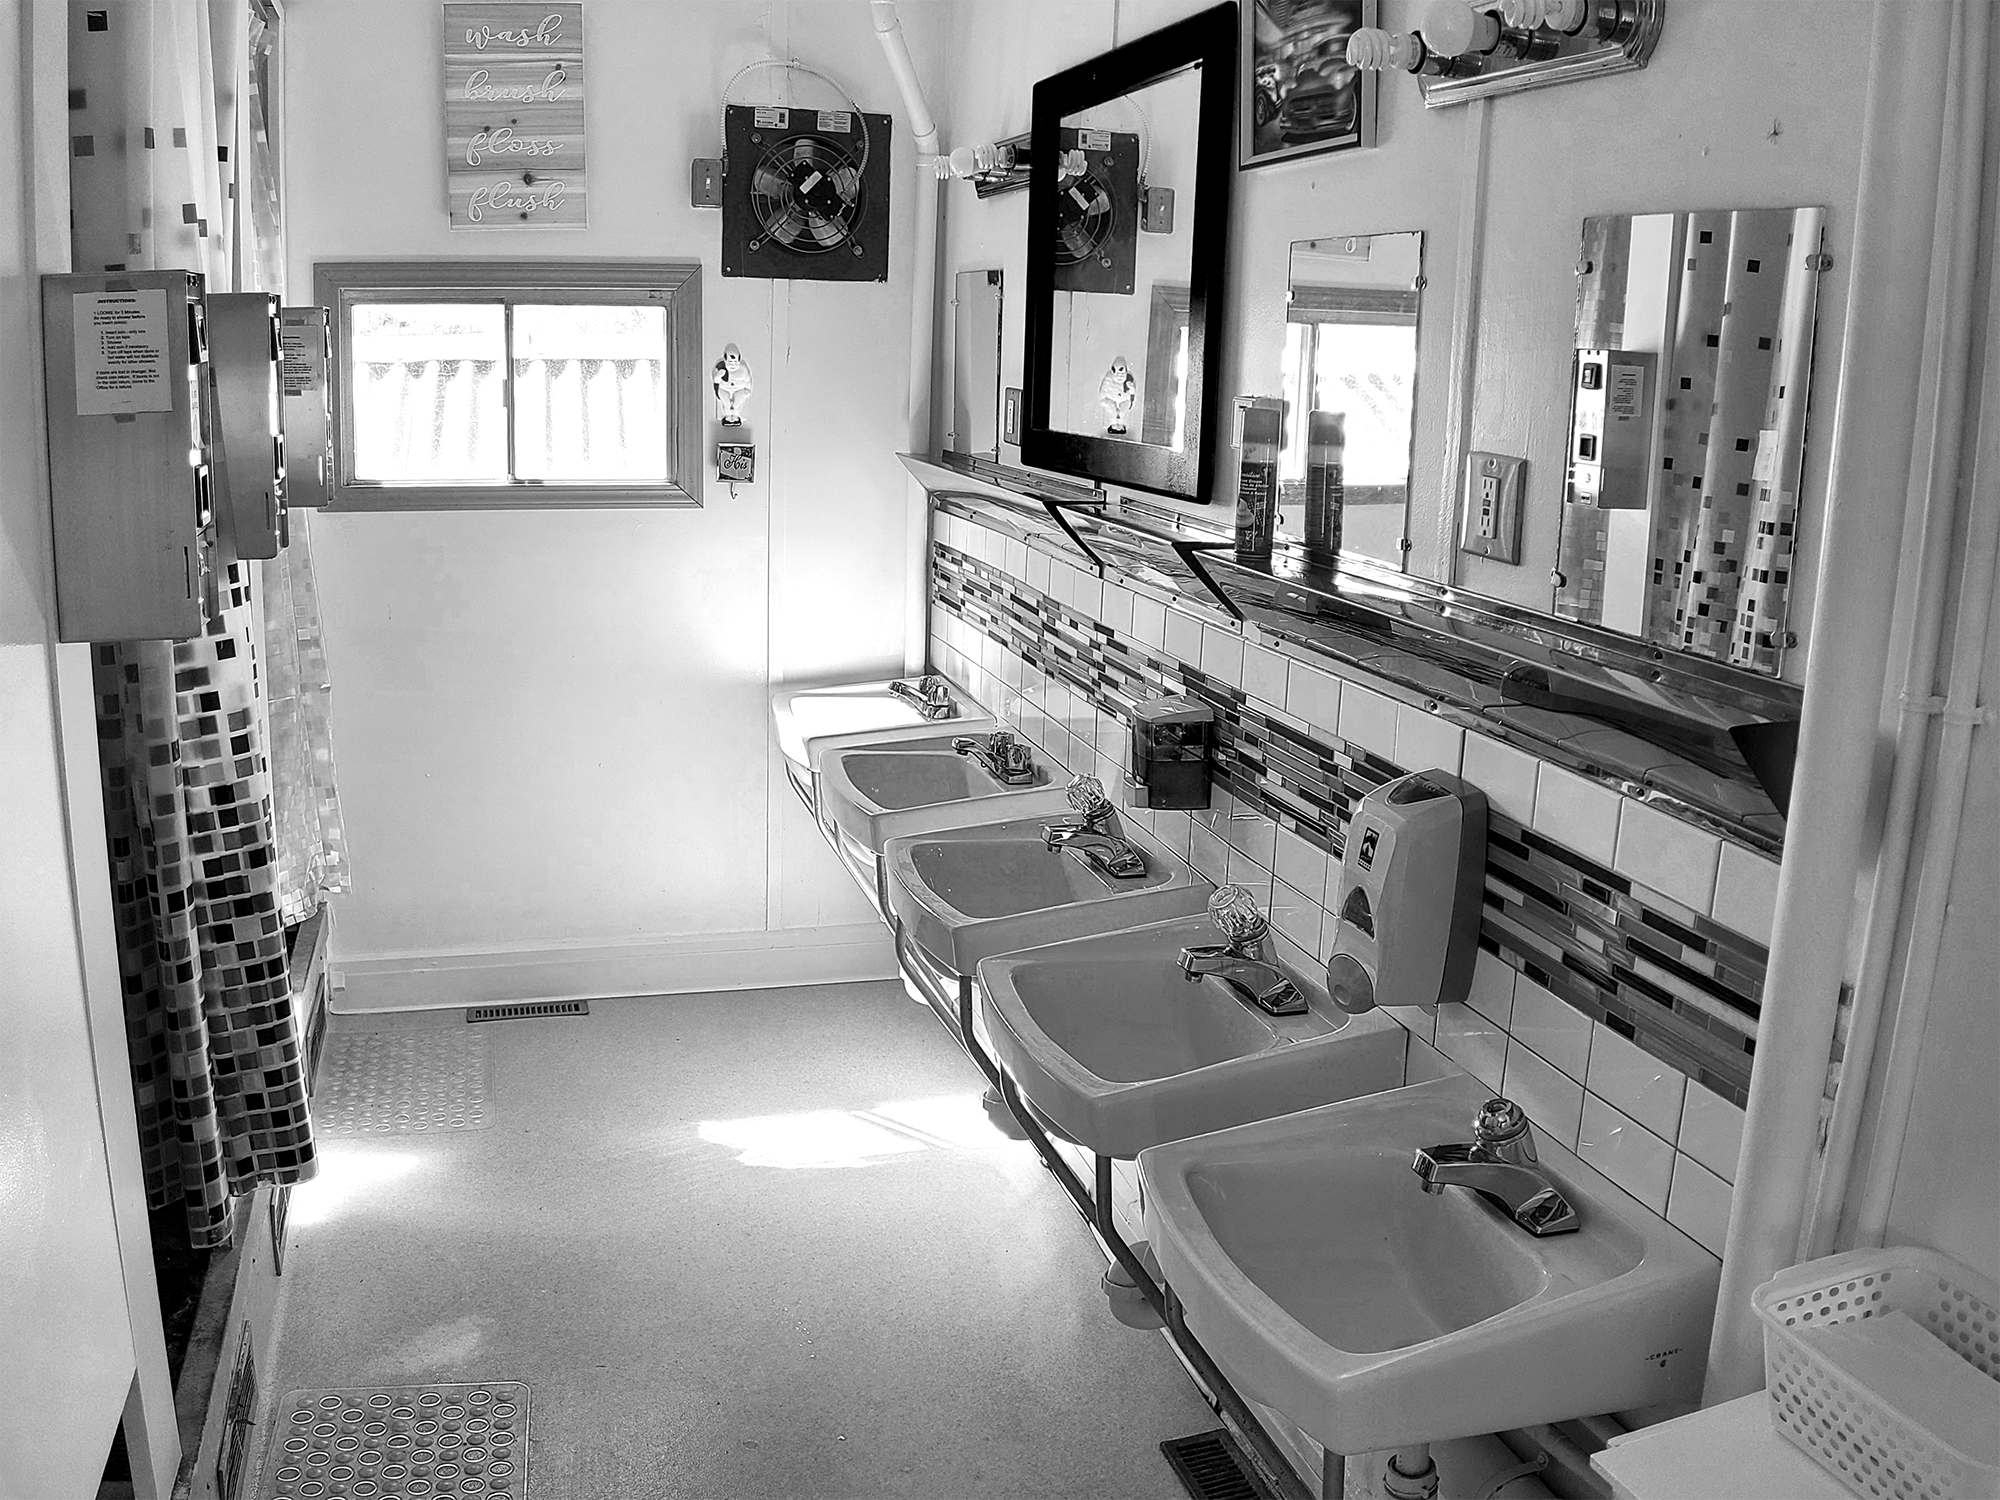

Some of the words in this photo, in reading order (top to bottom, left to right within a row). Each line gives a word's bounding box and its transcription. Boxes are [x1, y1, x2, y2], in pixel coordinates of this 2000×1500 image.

[465, 14, 563, 49] wash
[464, 70, 566, 103] brush
[466, 128, 565, 166] floss
[468, 181, 565, 222] flush
[723, 453, 748, 470] His
